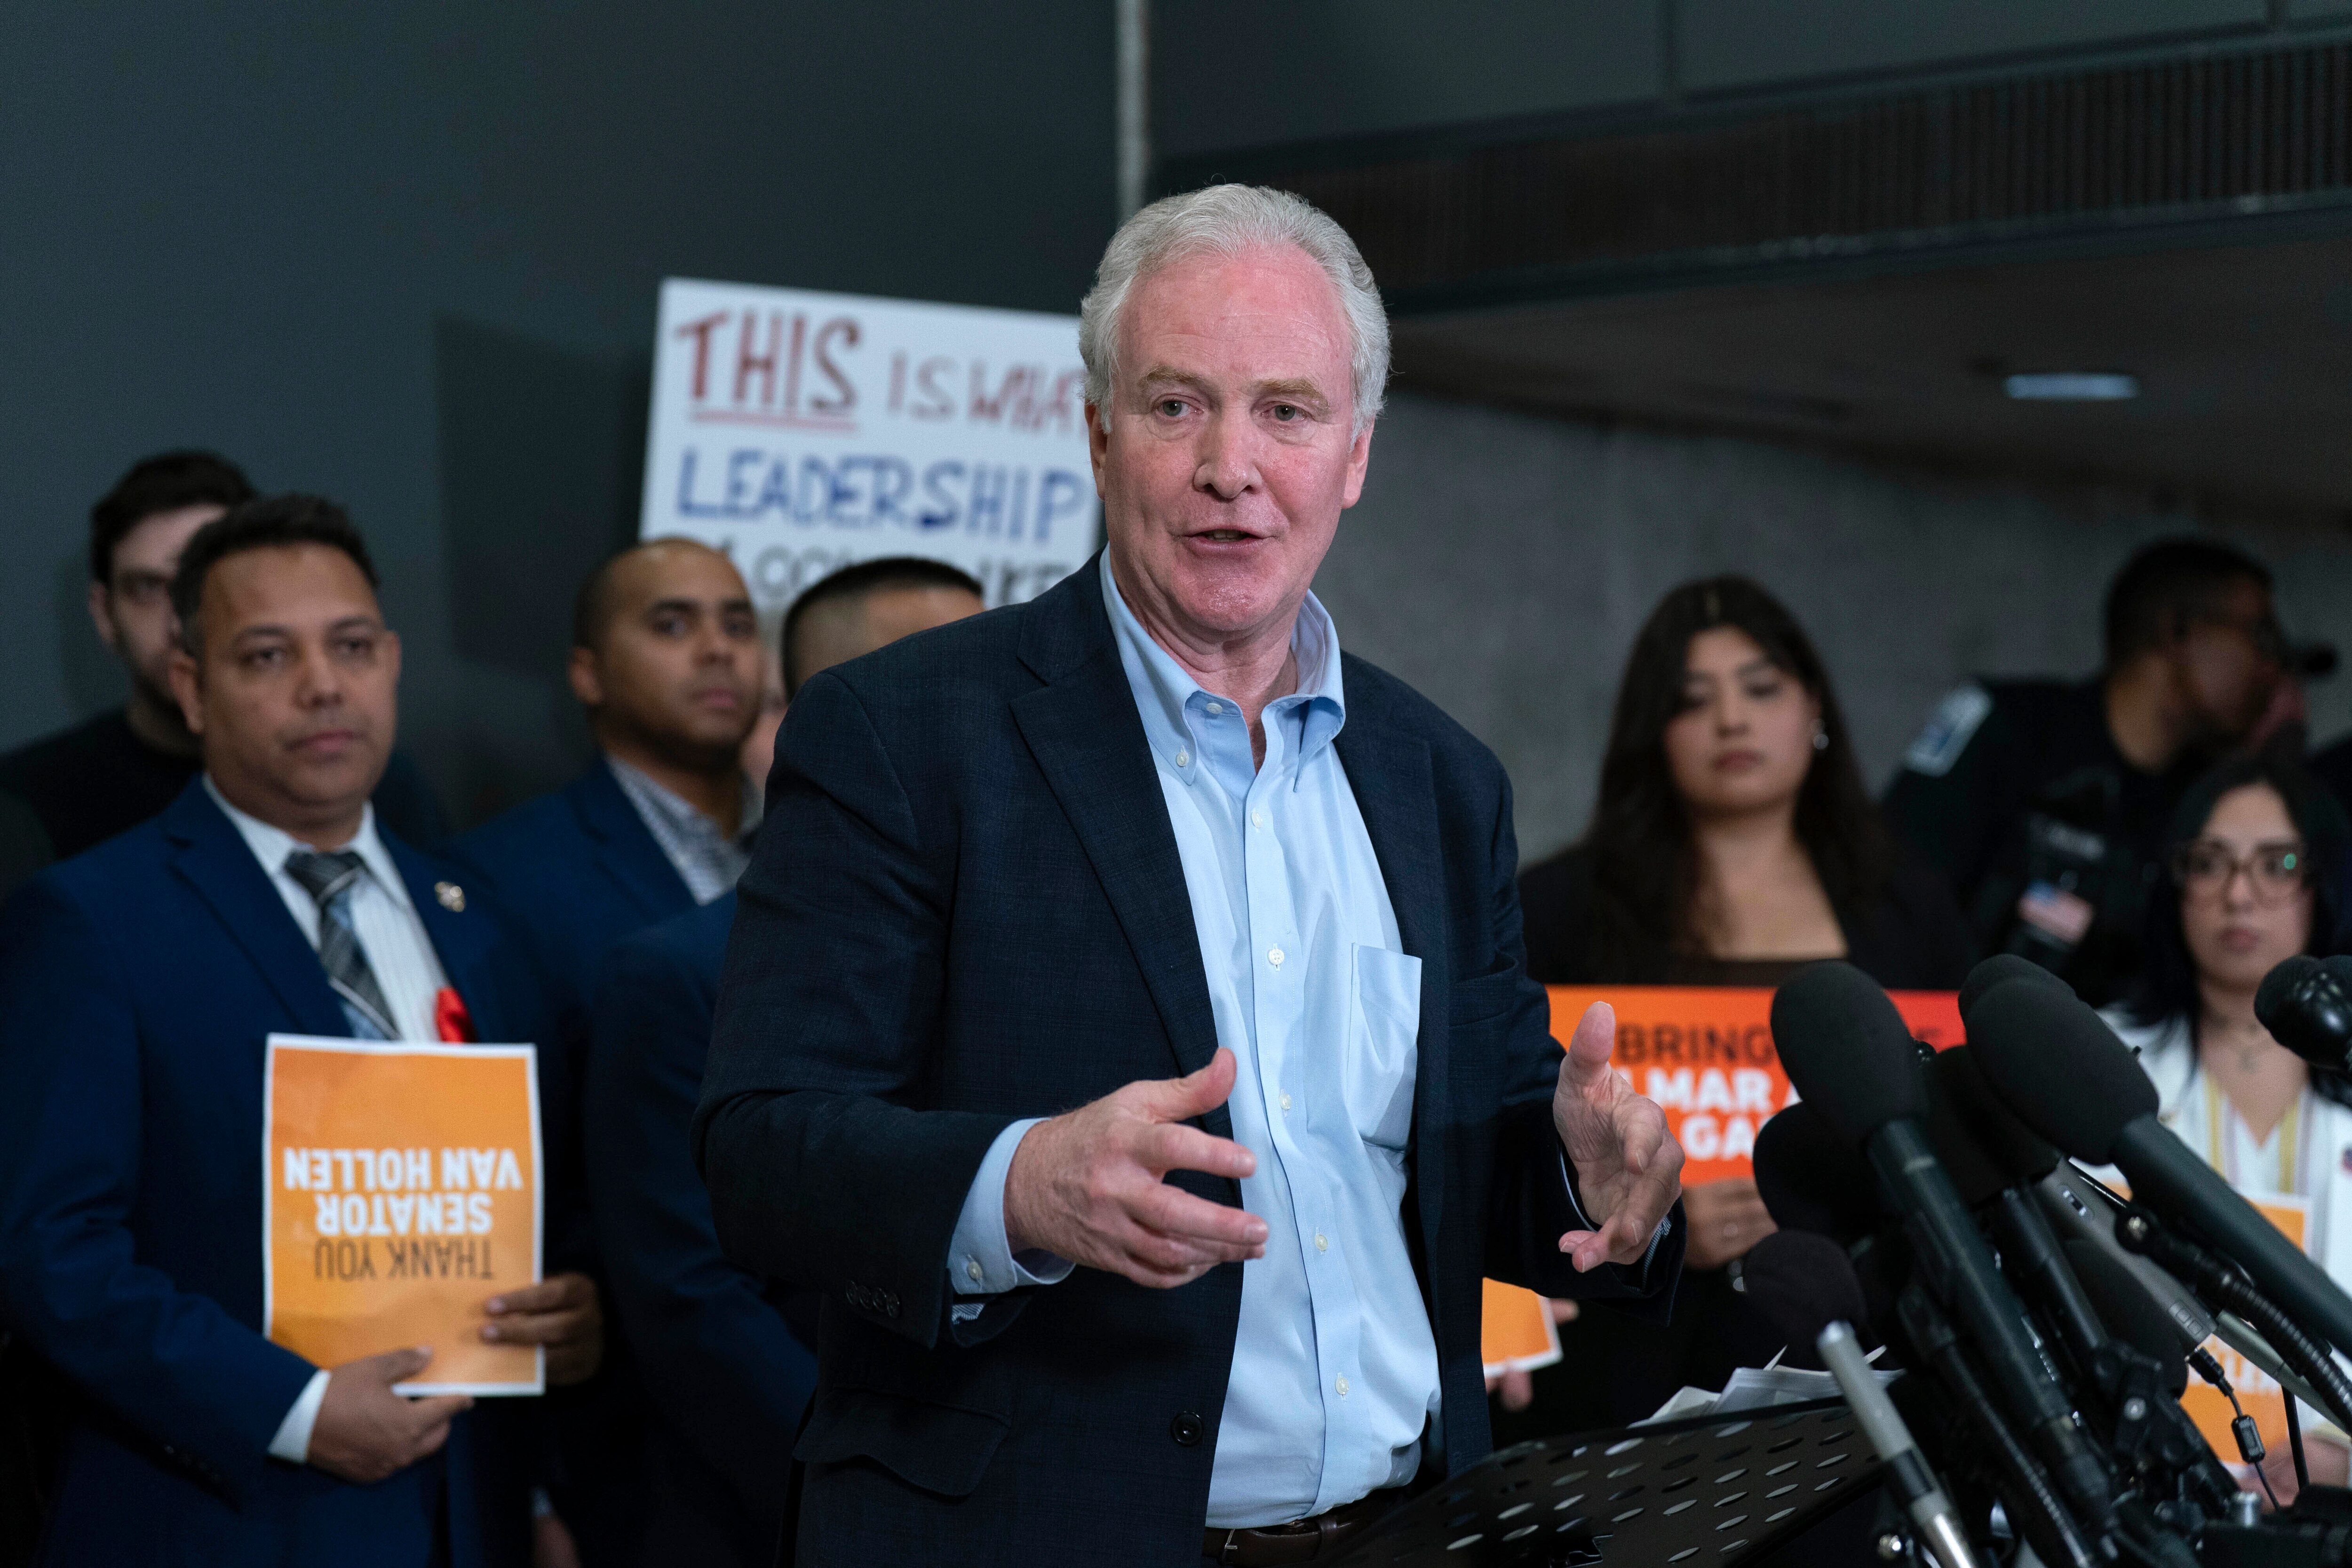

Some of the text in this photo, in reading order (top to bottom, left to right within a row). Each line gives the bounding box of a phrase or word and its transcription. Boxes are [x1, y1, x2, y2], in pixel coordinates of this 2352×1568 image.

[675, 309, 860, 413] THIS
[887, 352, 957, 422] IS
[676, 447, 1089, 541] LEADERSHIP
[1616, 1022, 1774, 1066] BRING
[1617, 1067, 1772, 1113] MAR
[284, 1147, 523, 1191] VAN HOLLEN
[315, 1193, 493, 1236] SENATOR
[314, 1238, 494, 1281] THANK YOU
